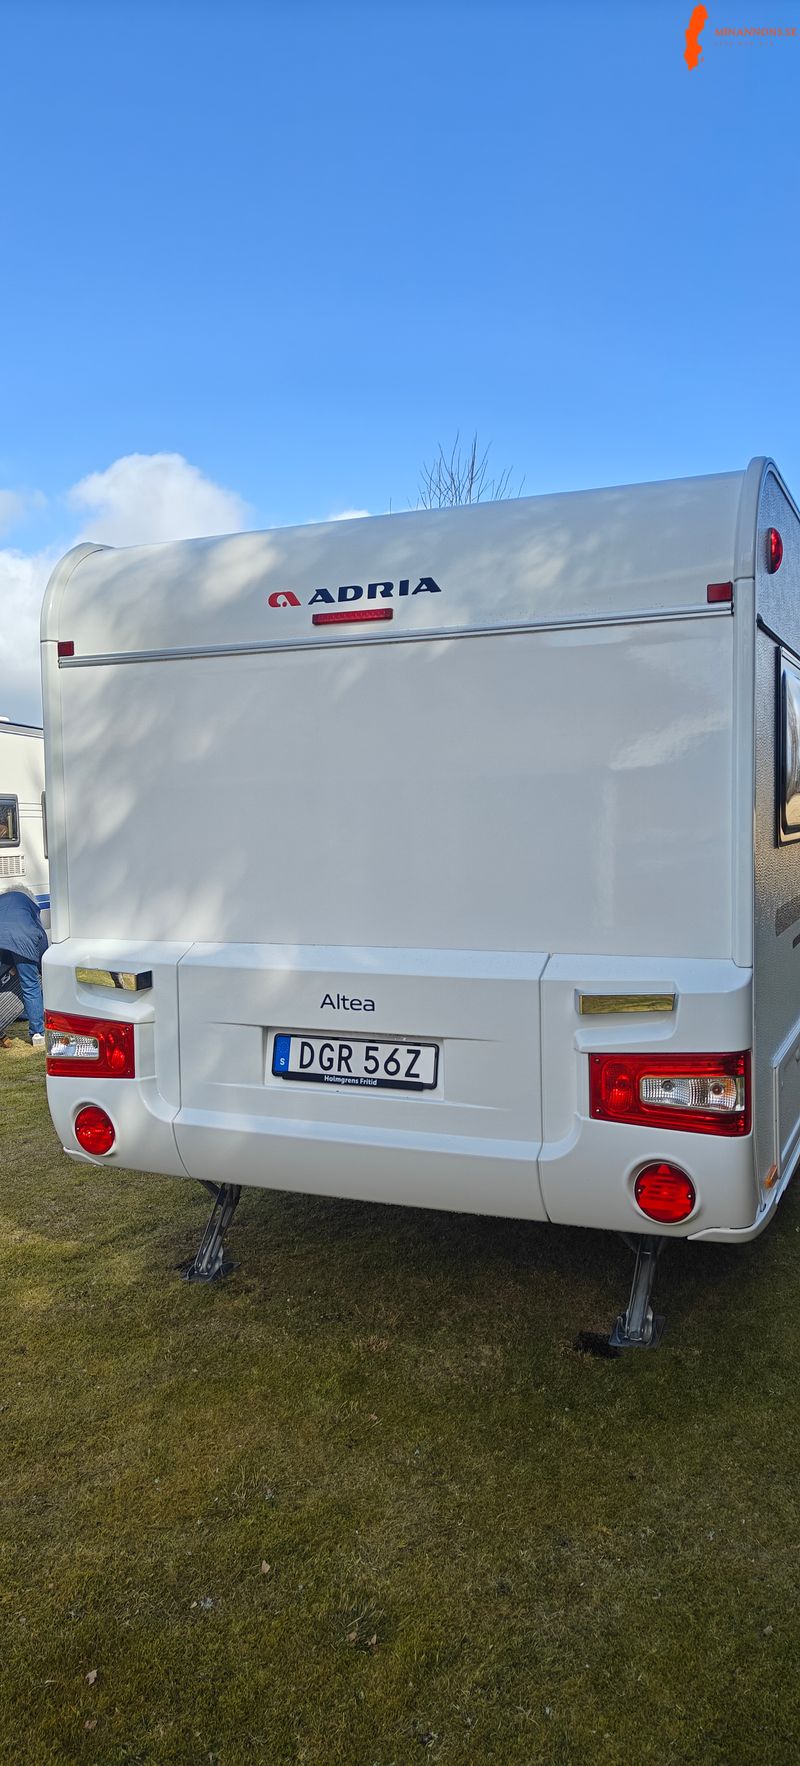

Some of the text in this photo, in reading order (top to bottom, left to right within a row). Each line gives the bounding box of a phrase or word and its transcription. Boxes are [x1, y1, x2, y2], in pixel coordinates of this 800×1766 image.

[307, 577, 442, 605] ADRIA
[320, 993, 376, 1012] Altea
[279, 1057, 286, 1066] S
[299, 1041, 422, 1079] DGR 56Z
[324, 1075, 378, 1086] Holmgrens Fritid
